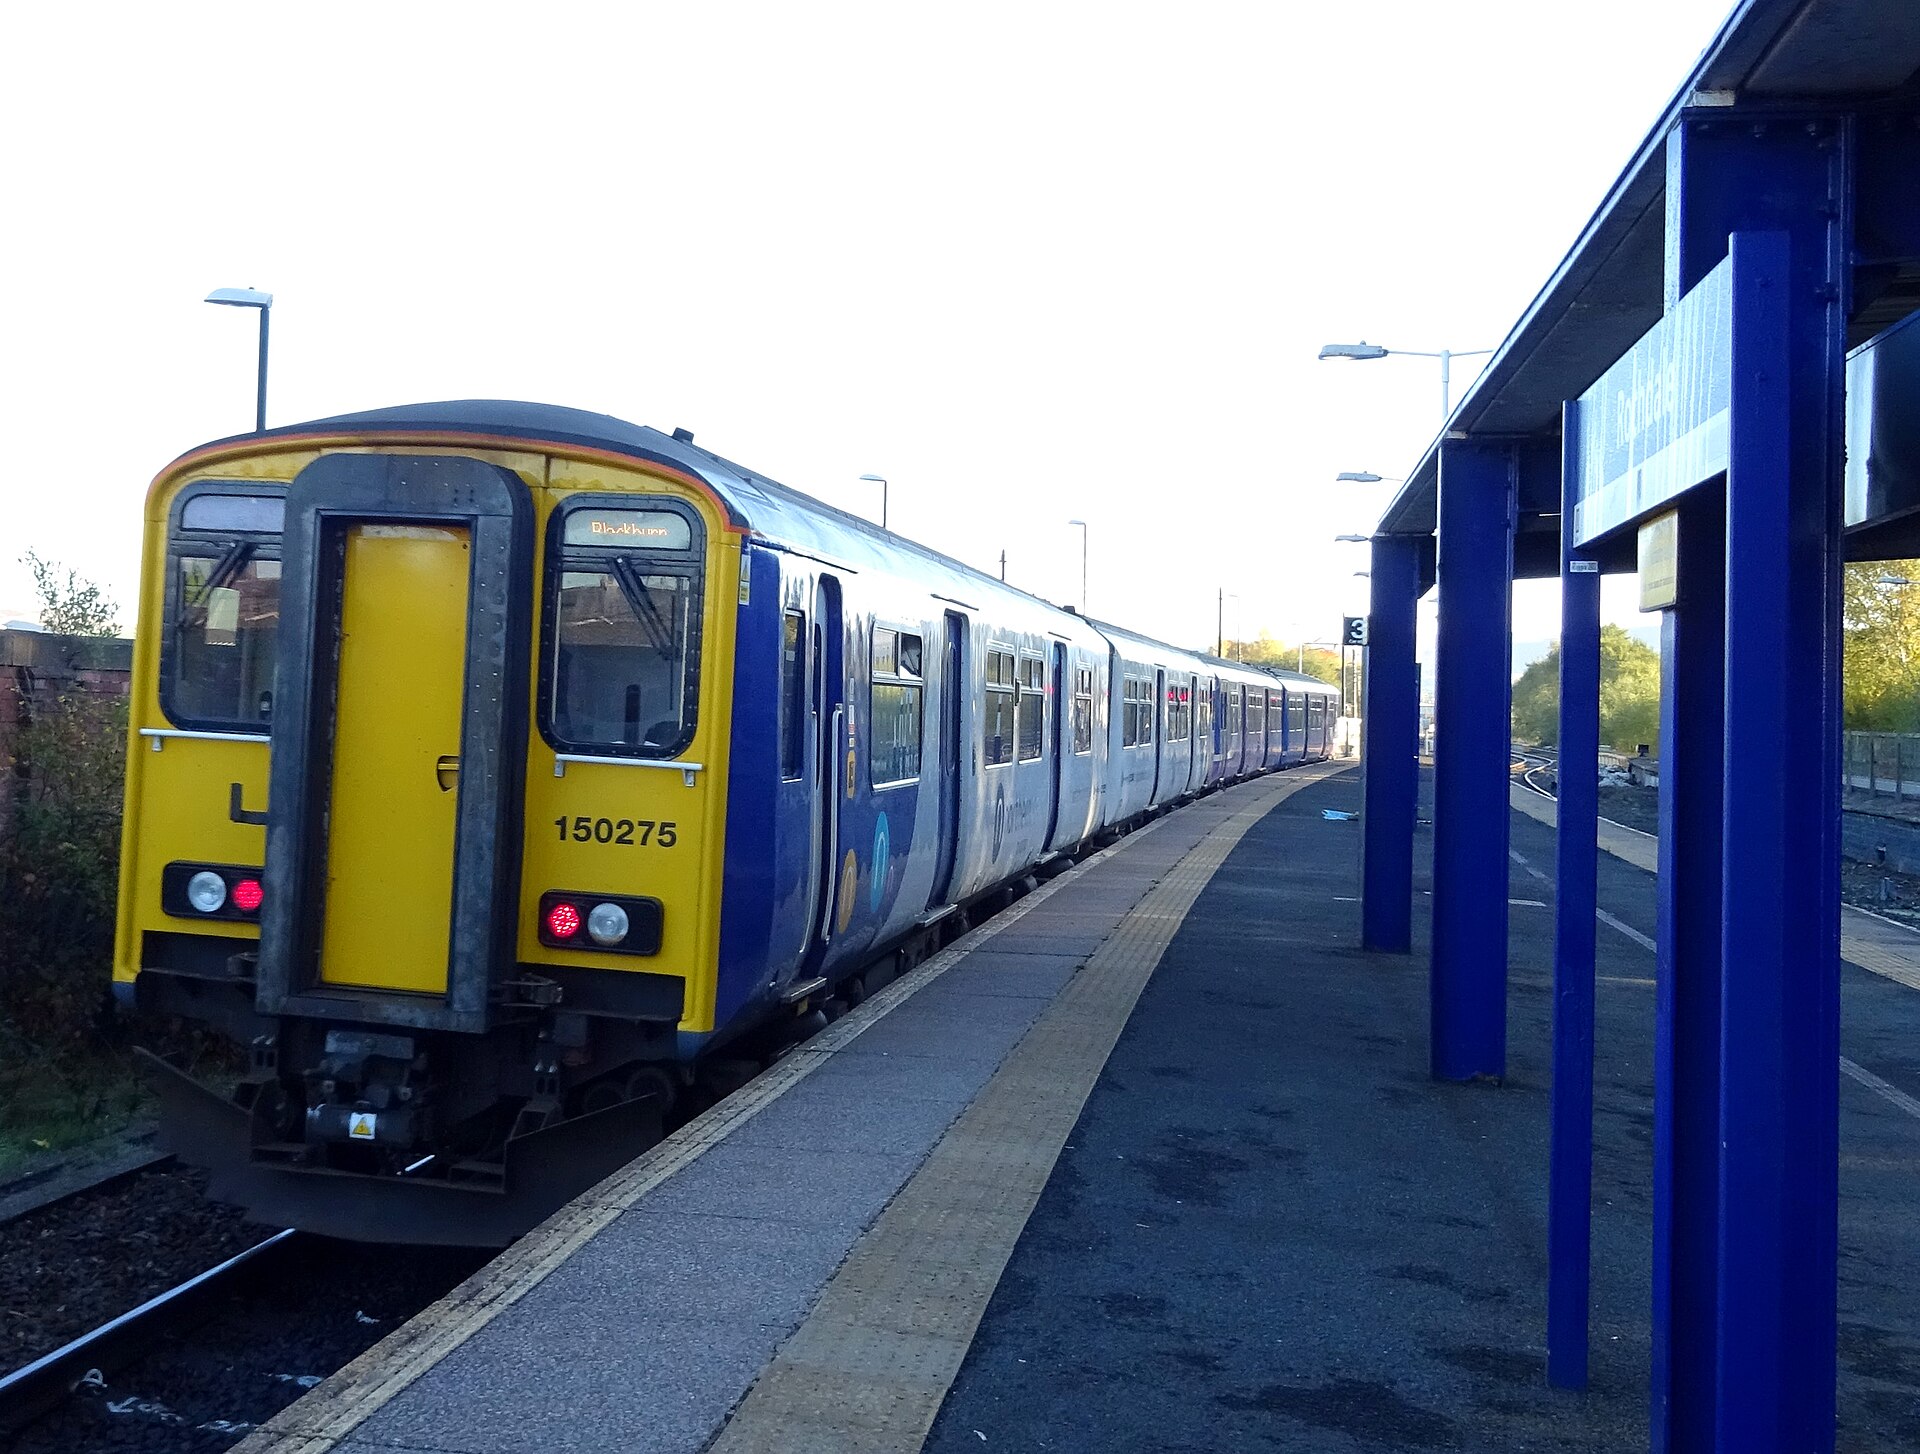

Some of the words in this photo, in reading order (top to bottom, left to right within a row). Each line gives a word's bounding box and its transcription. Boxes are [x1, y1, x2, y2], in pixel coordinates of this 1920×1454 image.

[590, 520, 669, 537] Blackburn
[1350, 618, 1366, 640] 3
[555, 815, 677, 848] 150275
